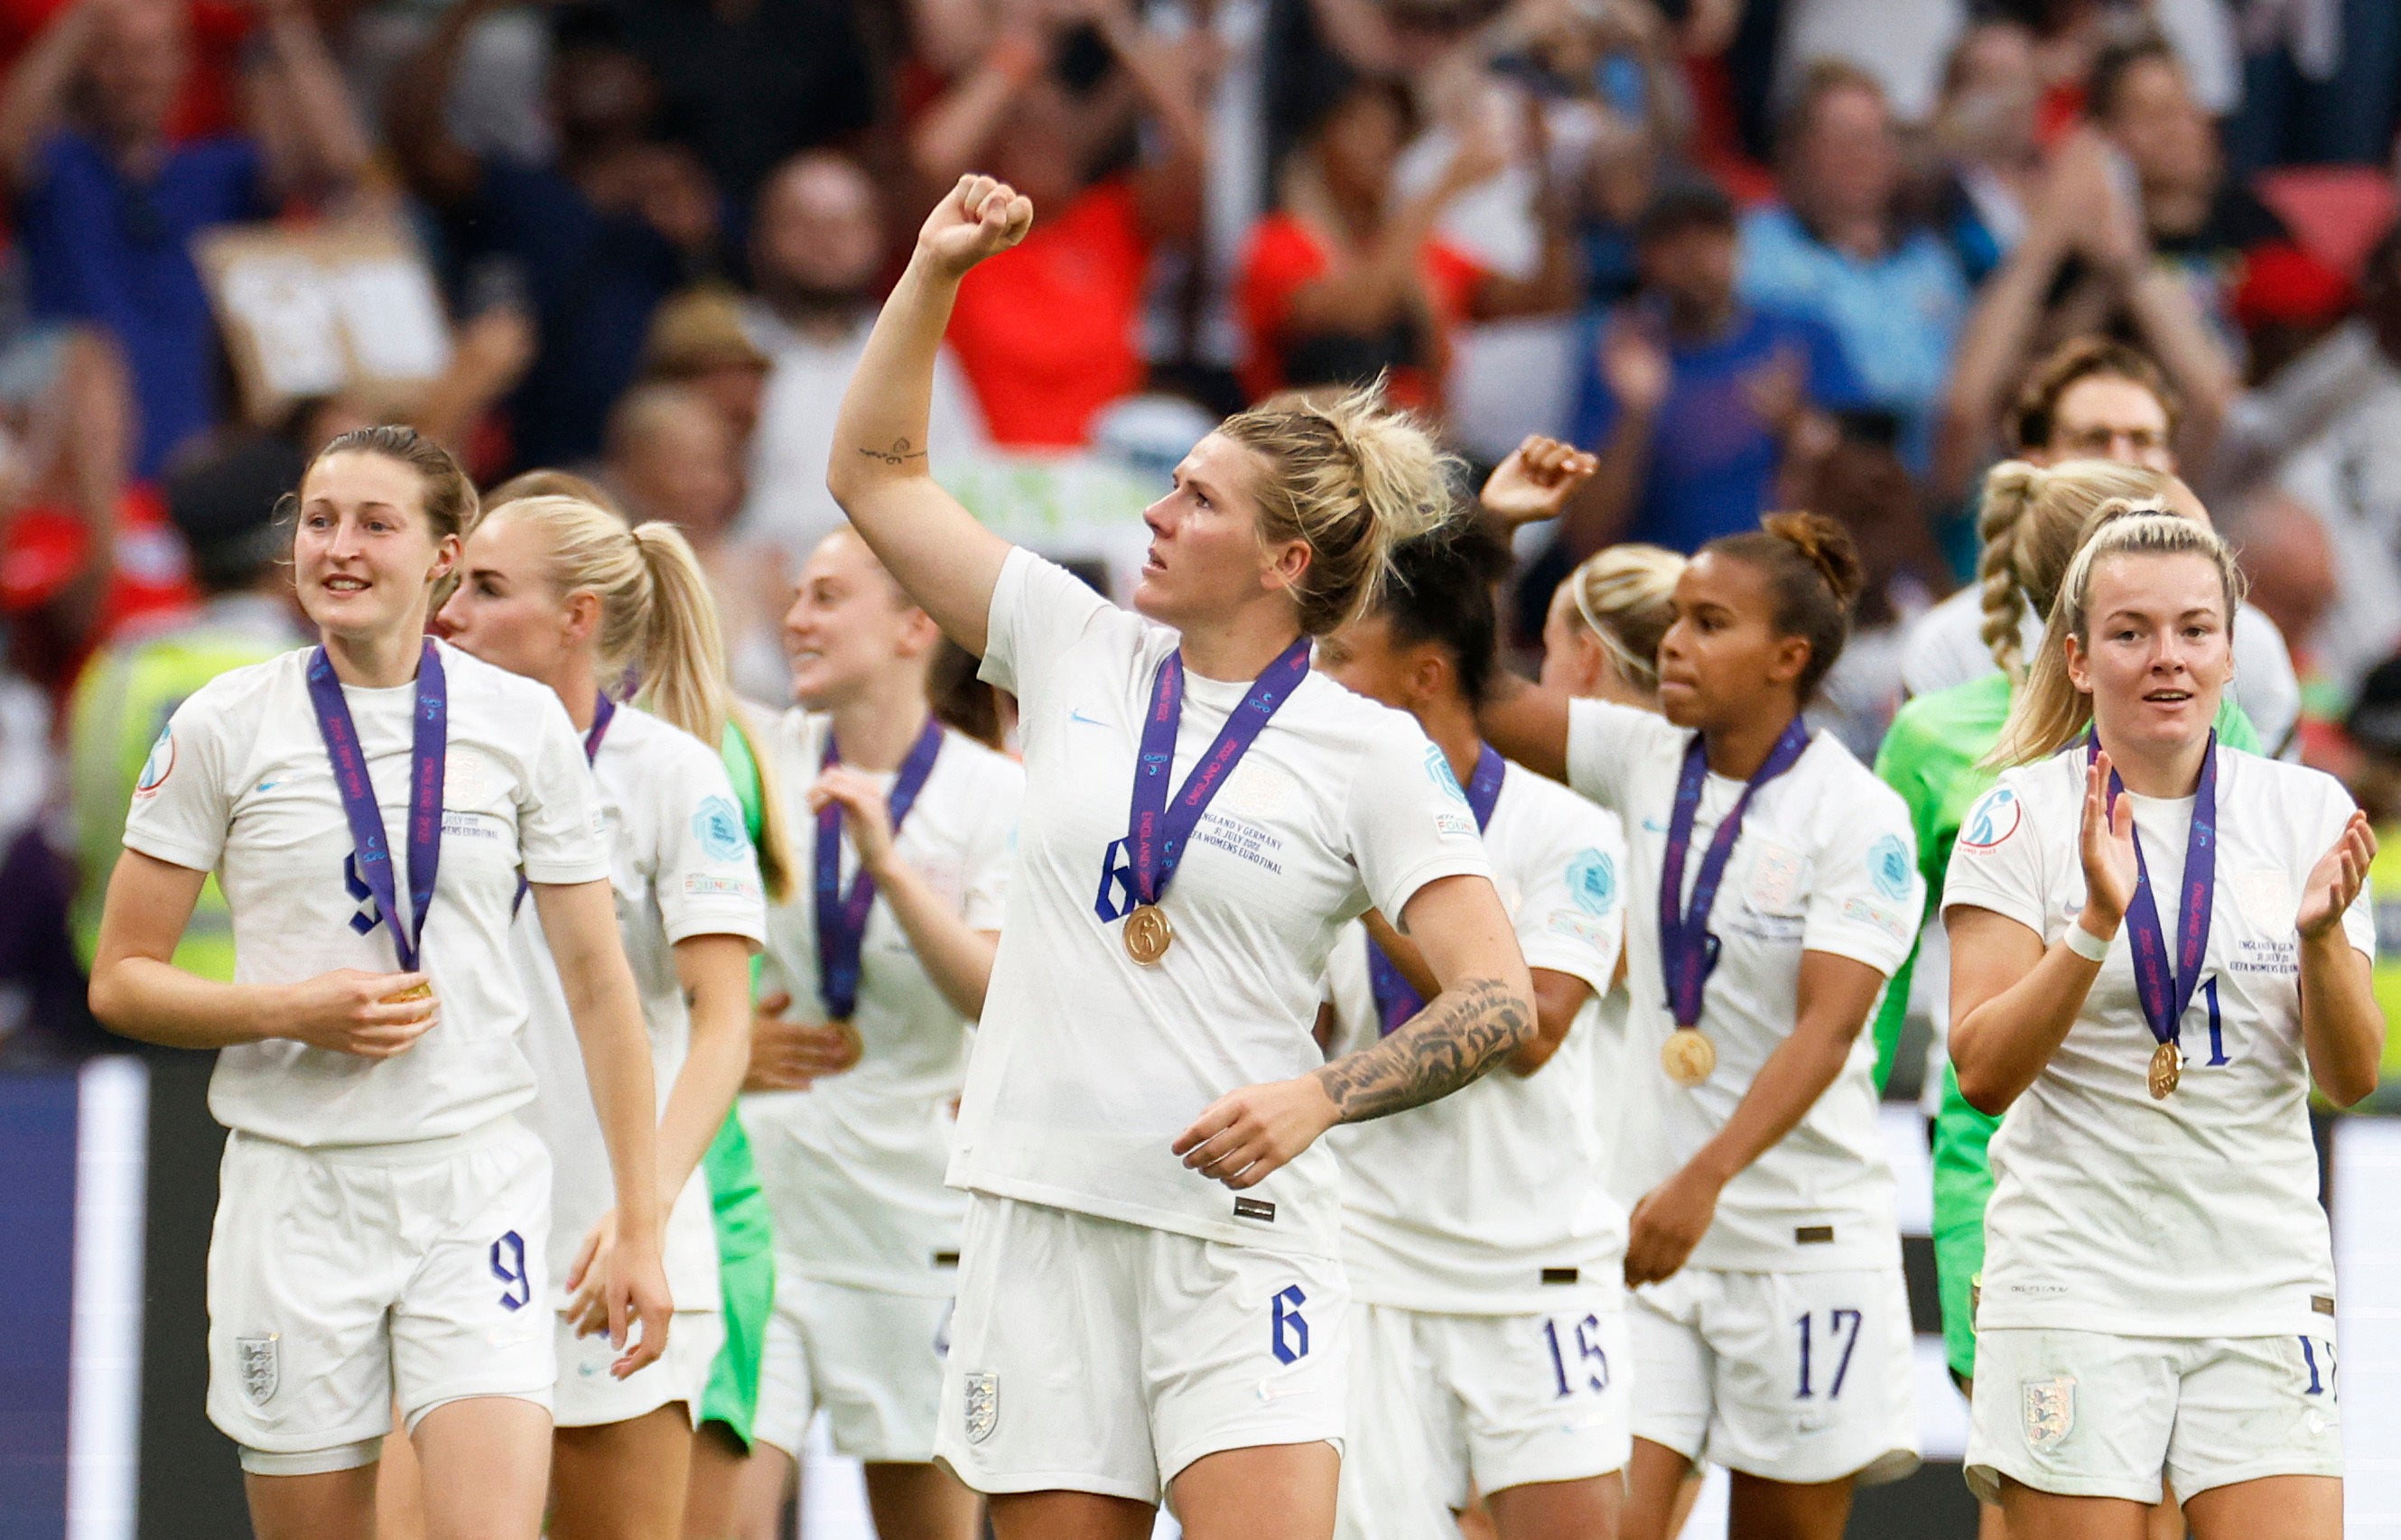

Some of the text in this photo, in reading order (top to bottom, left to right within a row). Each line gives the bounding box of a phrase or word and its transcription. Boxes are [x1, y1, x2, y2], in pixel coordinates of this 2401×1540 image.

[1185, 738, 1239, 805] ENGLAND 2022
[1138, 811, 1154, 867] ENGLAND
[1202, 812, 1236, 830] NGLAND
[1242, 826, 1283, 850] GERMANY
[1204, 833, 1239, 854] WOMENS
[1238, 847, 1261, 866] EURO
[1259, 857, 1282, 875] FINAL
[1224, 830, 1245, 844] JULY
[1094, 835, 1139, 923] 6
[490, 1229, 530, 1313] 9
[1271, 1284, 1309, 1366] 6
[1543, 1313, 1609, 1399] 15
[1793, 1308, 1862, 1400] 17
